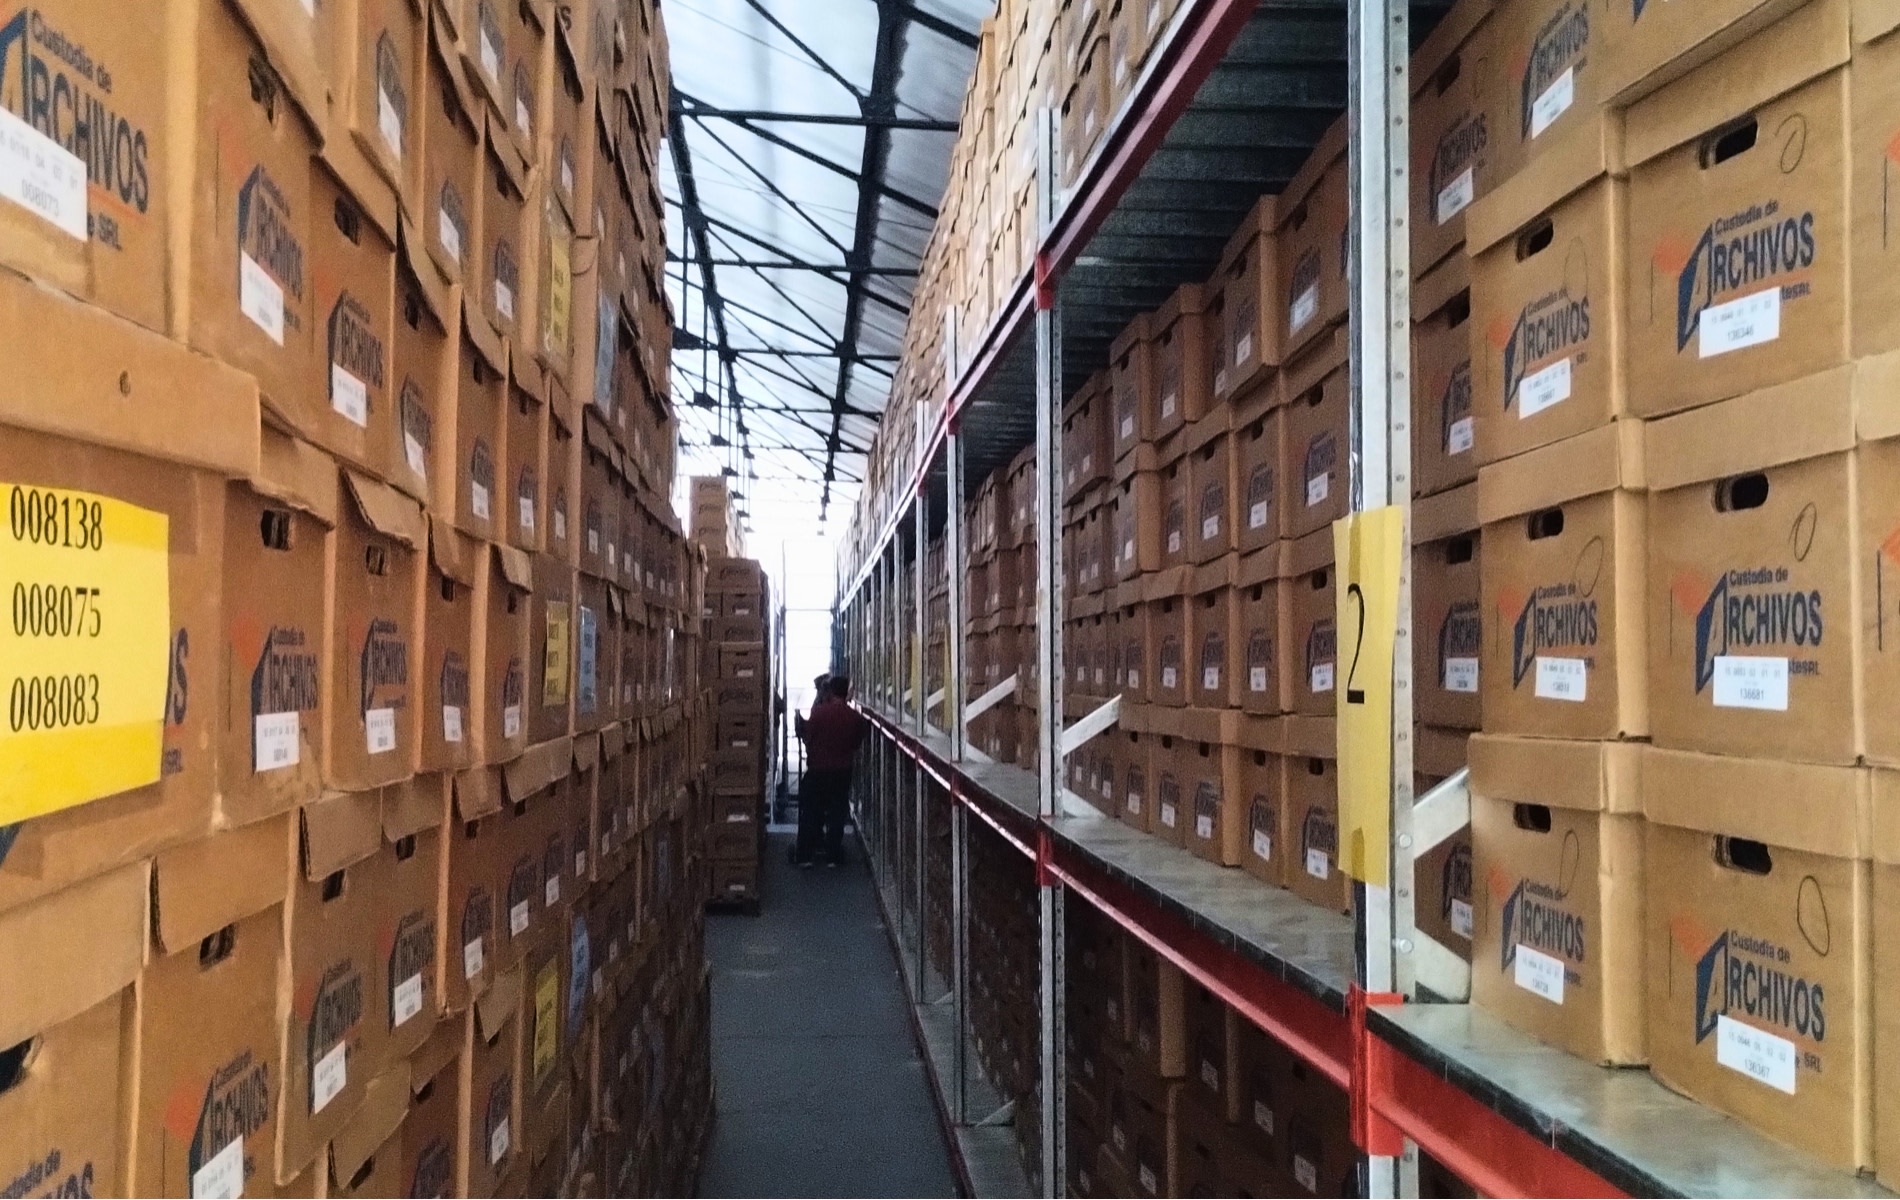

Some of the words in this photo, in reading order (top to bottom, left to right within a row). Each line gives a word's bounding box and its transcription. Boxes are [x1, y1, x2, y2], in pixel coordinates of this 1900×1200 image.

[1714, 205, 1762, 236] Custodia
[1765, 199, 1779, 216] de
[10, 485, 103, 552] 008138
[1729, 567, 1773, 587] Custodia
[1775, 566, 1788, 583] de
[12, 581, 102, 638] 008075
[1346, 582, 1365, 704] 2
[9, 673, 99, 733] 008083
[1730, 930, 1775, 959] Custodia
[1777, 946, 1790, 964] de
